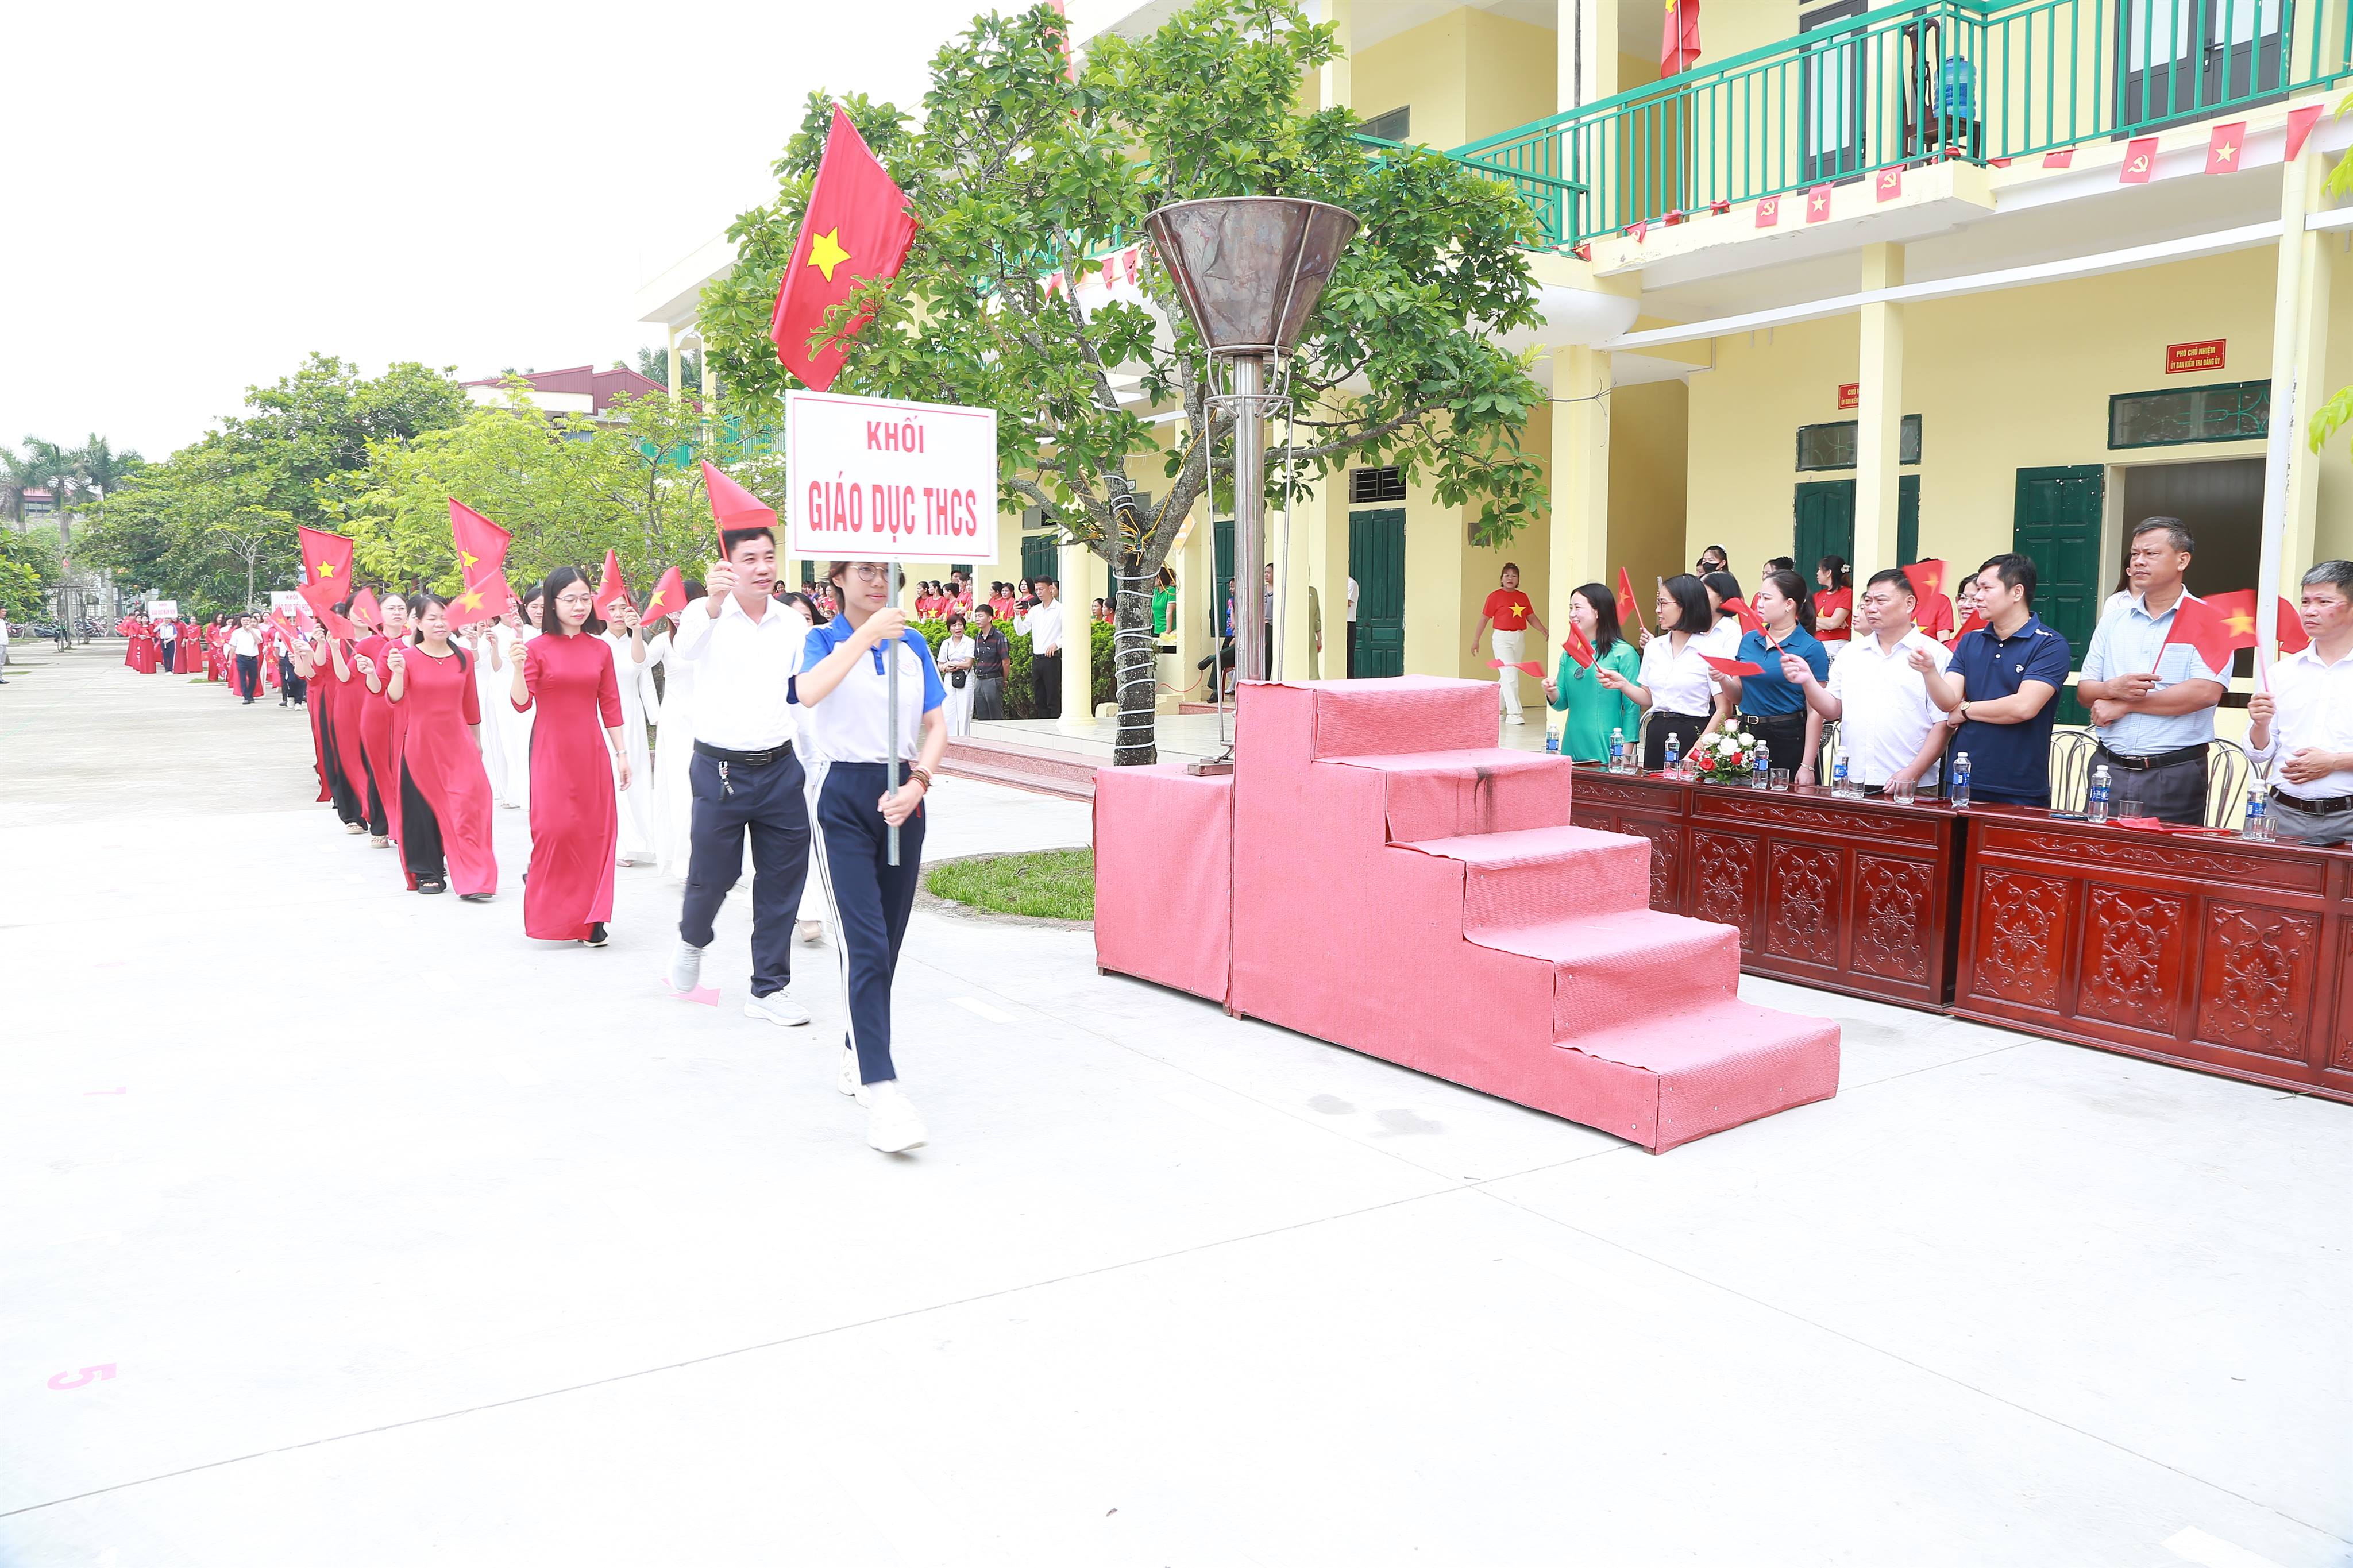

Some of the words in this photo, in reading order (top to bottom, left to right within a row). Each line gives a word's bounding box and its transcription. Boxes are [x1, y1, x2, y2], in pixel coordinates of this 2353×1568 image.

[2176, 349, 2186, 357] PHÓ
[2188, 346, 2198, 356] CHỦ
[2198, 346, 2216, 356] NHIỆM
[867, 415, 924, 453] KHỐI
[809, 471, 862, 532] GIÁO
[872, 484, 915, 543] DỤC
[924, 488, 977, 536] THCS
[47, 1362, 117, 1391] 5
